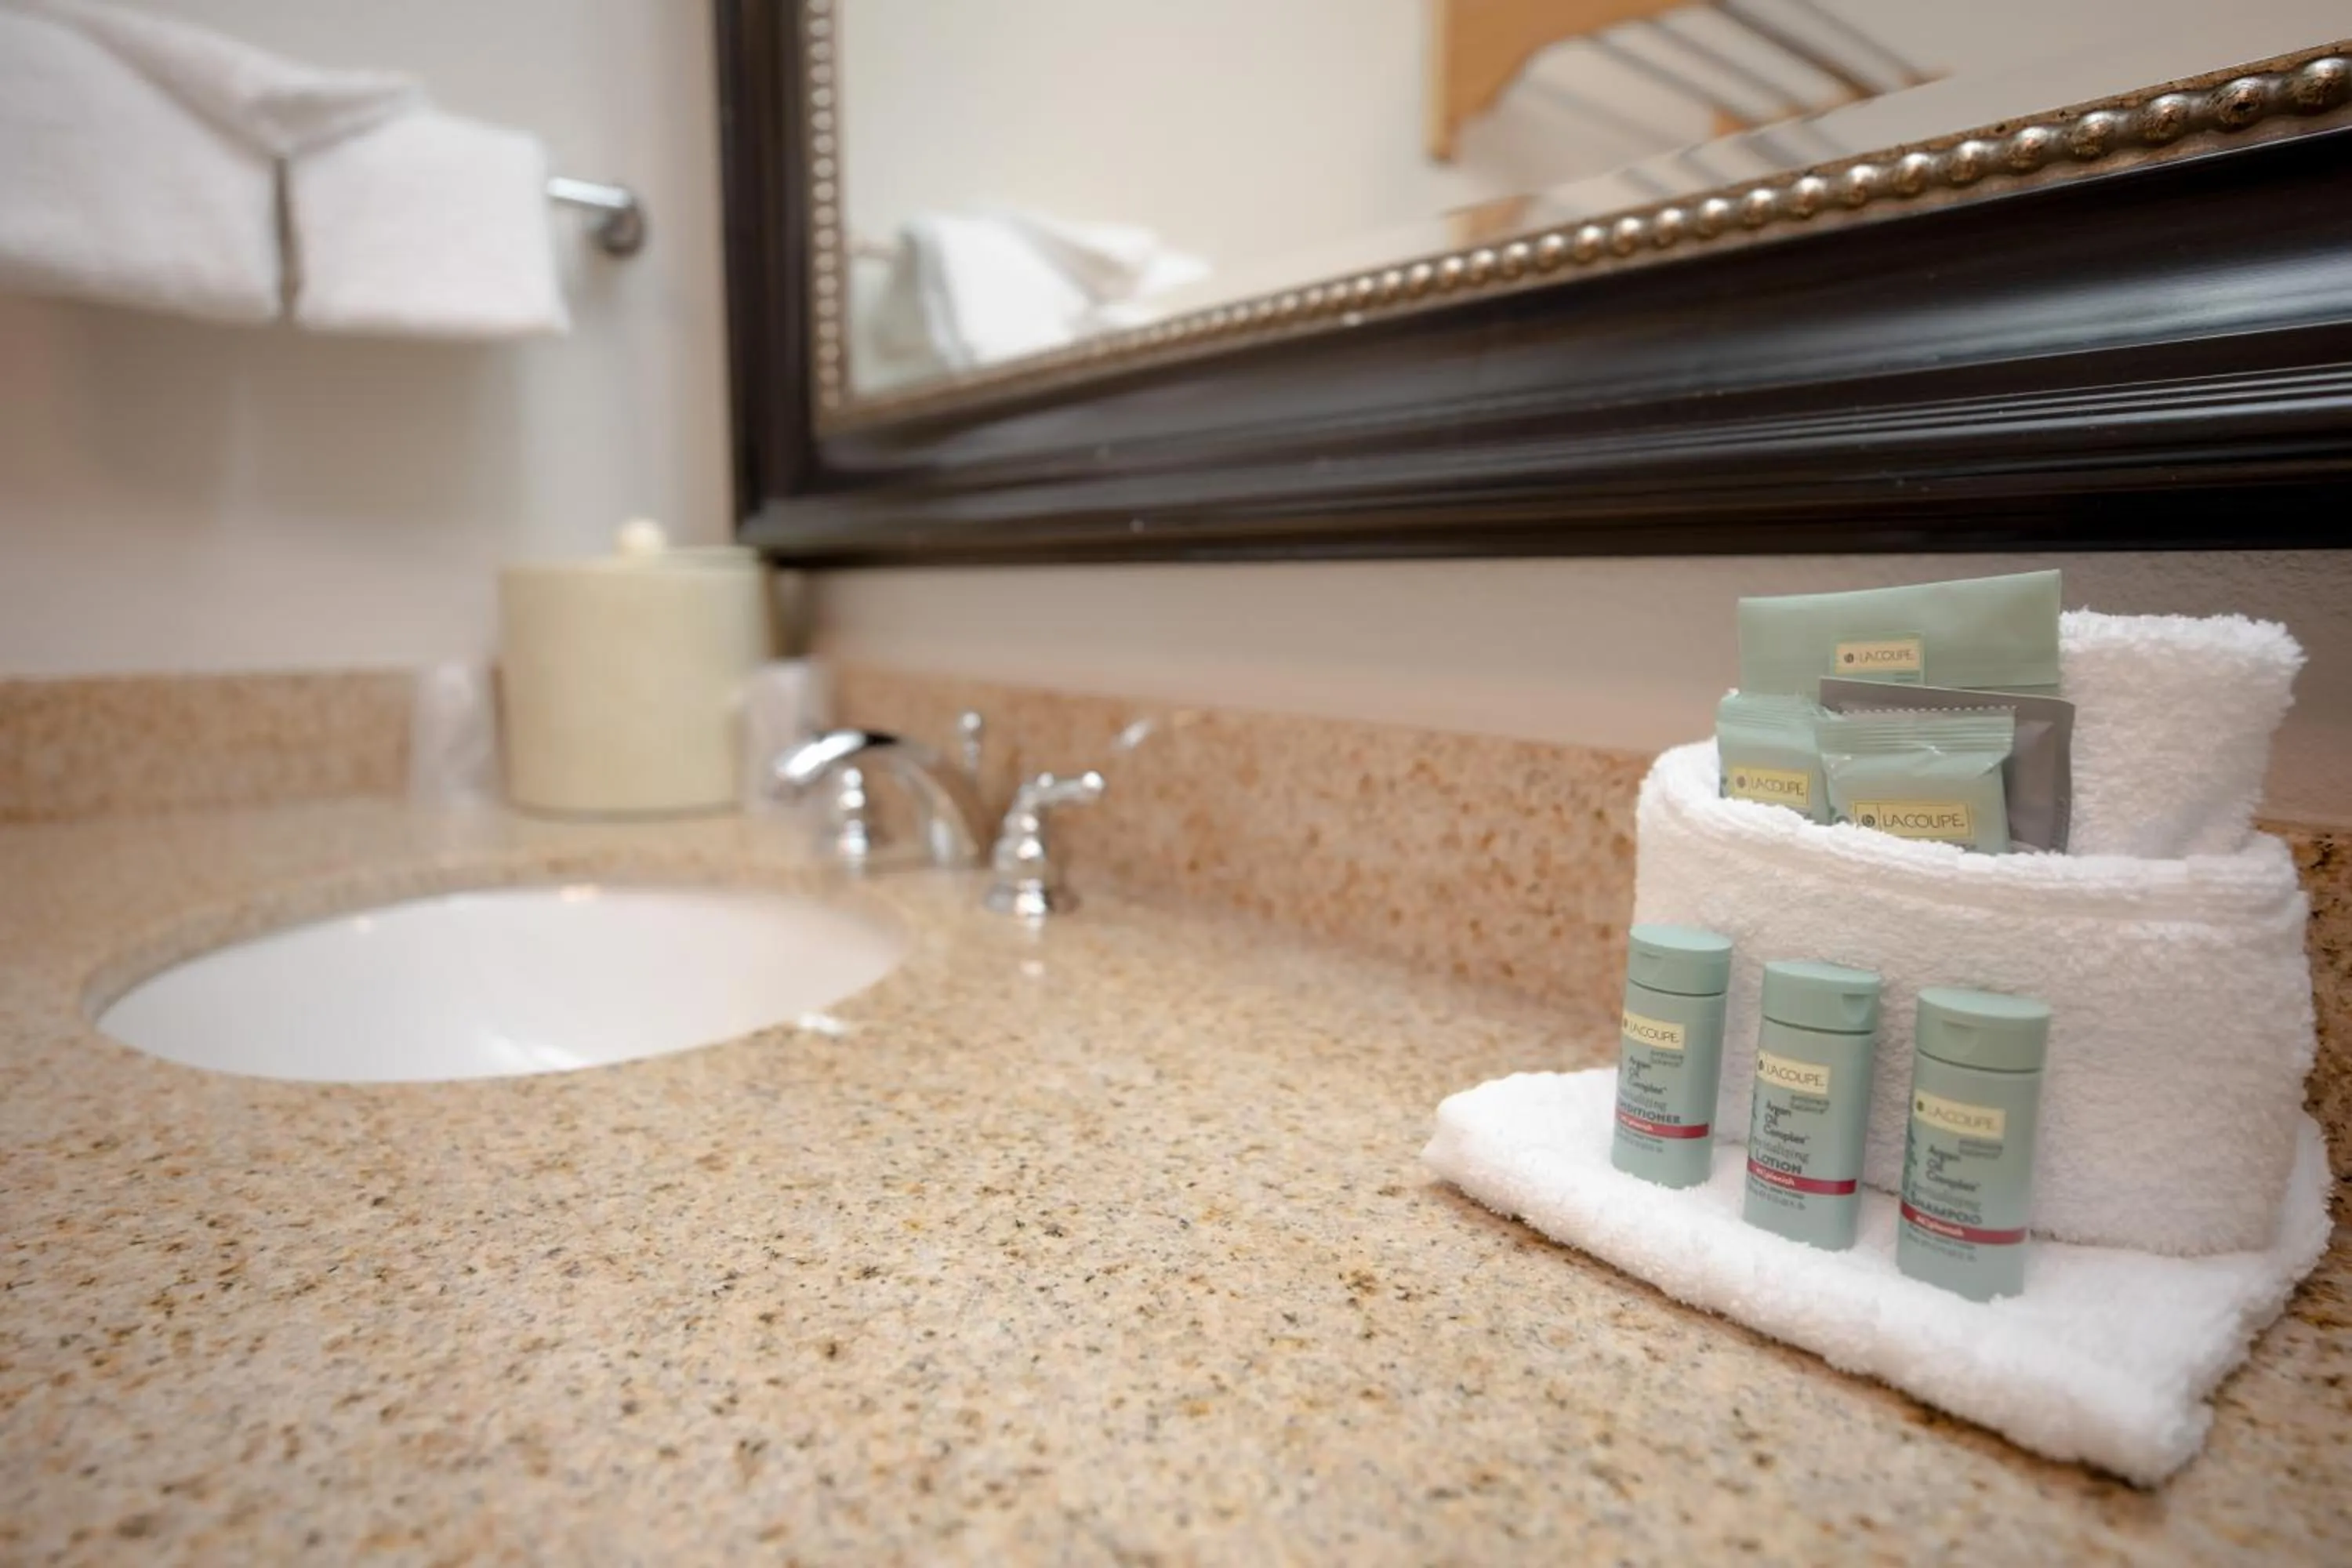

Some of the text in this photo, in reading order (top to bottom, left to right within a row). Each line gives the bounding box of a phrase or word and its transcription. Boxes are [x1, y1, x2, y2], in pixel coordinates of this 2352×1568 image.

[1751, 777, 1805, 797] LACOUPE
[1883, 812, 1965, 829] LACOUPE
[1766, 1065, 1826, 1087] LACOUPE
[1755, 1148, 1802, 1174] LOTION
